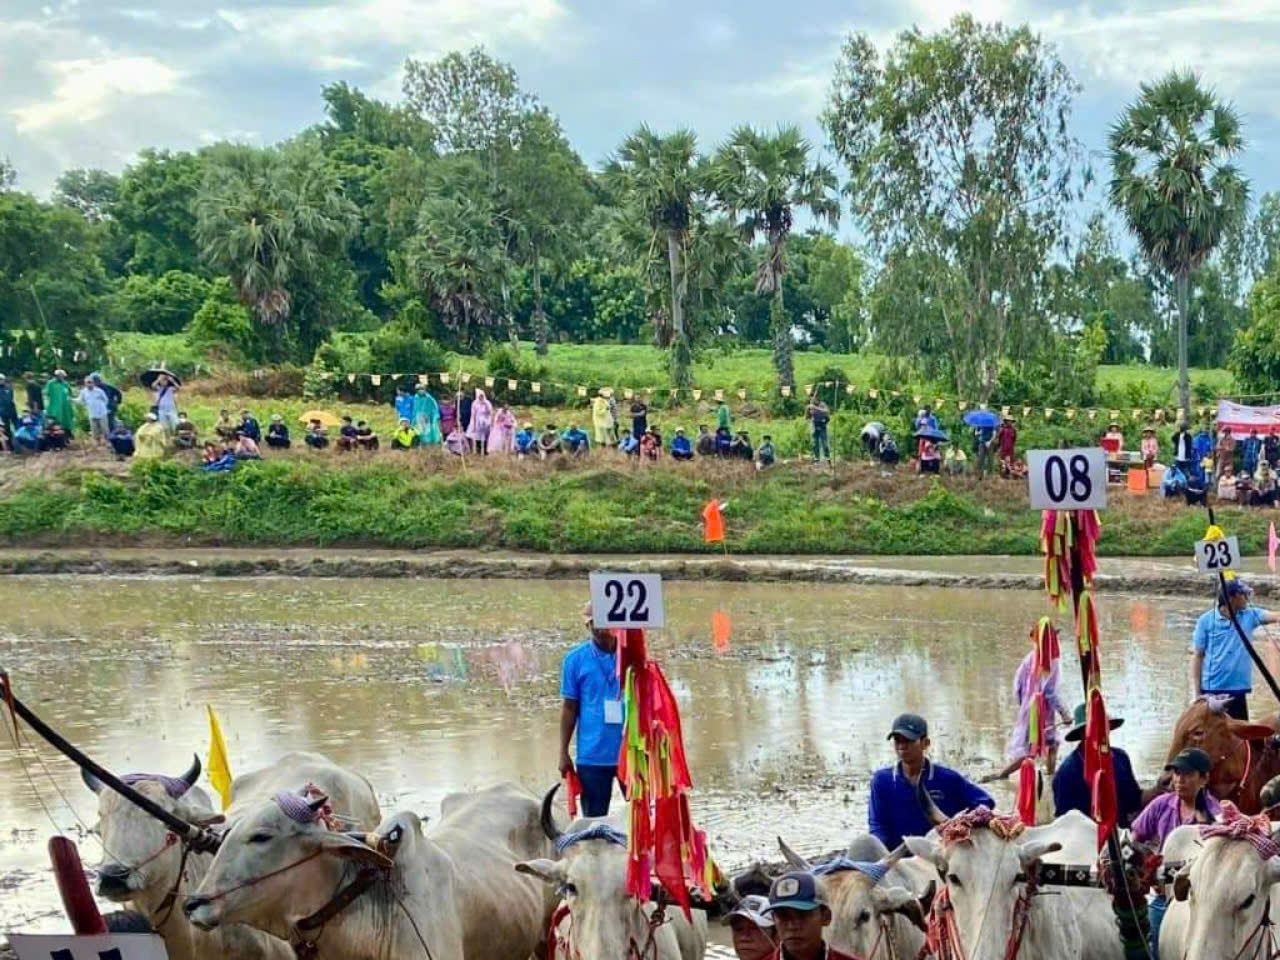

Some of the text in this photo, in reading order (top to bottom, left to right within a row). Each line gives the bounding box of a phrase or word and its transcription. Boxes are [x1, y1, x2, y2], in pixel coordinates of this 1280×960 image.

[1045, 454, 1092, 503] 08
[1204, 541, 1232, 569] 23
[605, 579, 649, 621] 22
